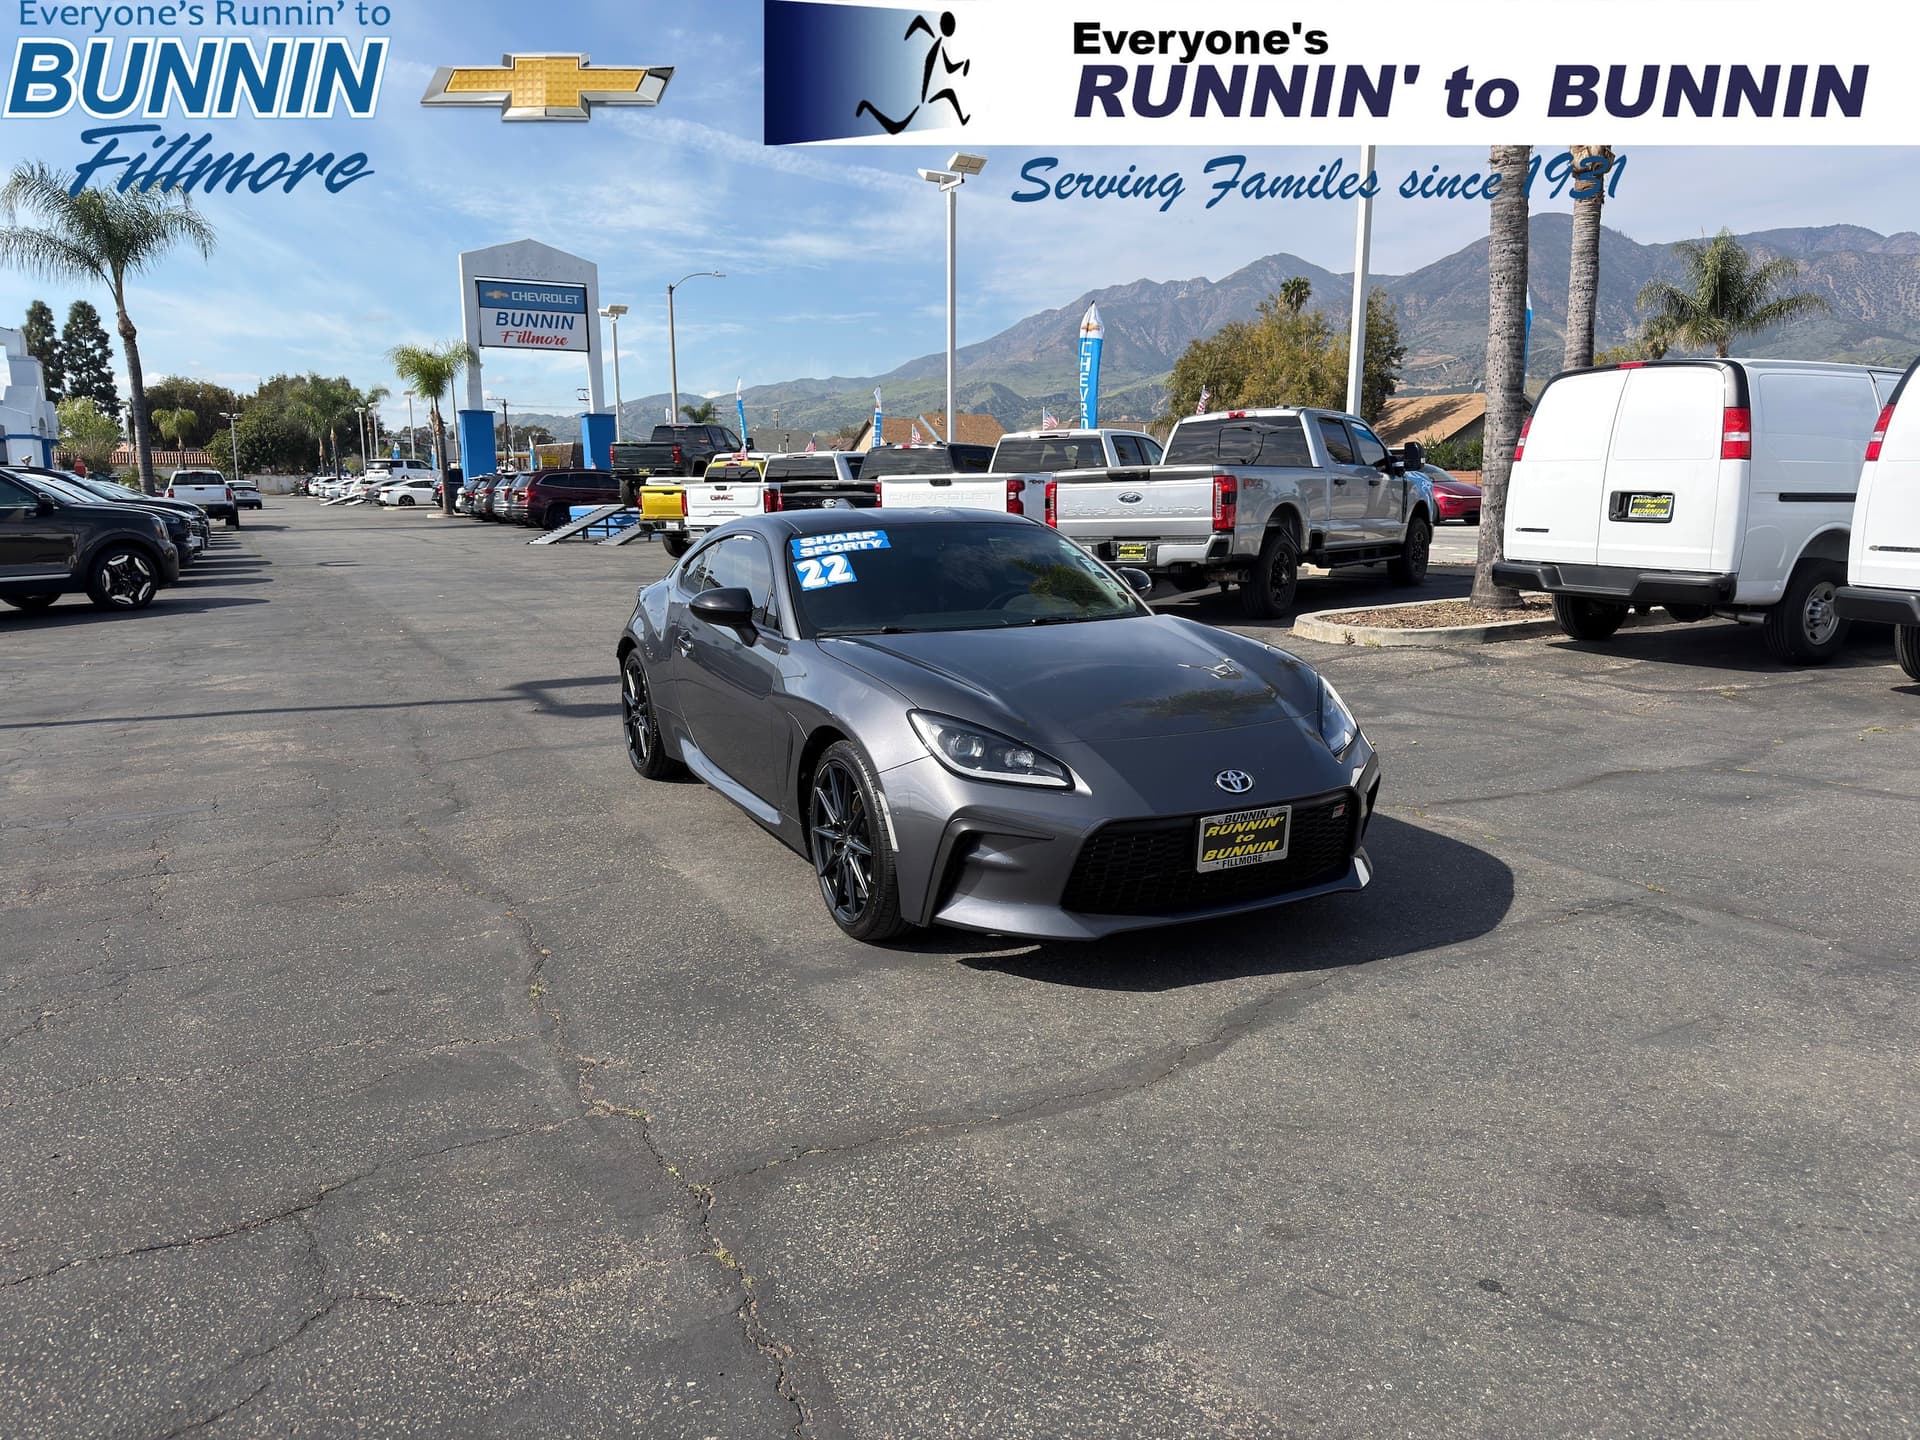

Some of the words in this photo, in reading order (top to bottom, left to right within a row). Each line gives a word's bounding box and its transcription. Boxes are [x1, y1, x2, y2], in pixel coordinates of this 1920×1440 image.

[511, 291, 579, 305] CHEVROLET
[495, 311, 575, 330] BUNNIN
[501, 330, 568, 346] Fillmore
[800, 530, 878, 547] SHARP
[800, 539, 883, 557] SPORTY
[797, 554, 852, 588] 22
[1224, 810, 1269, 824] BUNNIN
[1204, 816, 1285, 837] RUNNIN'
[1235, 834, 1255, 843] to
[1202, 839, 1279, 862] BUNNIN
[1222, 854, 1264, 869] FILLMORE
